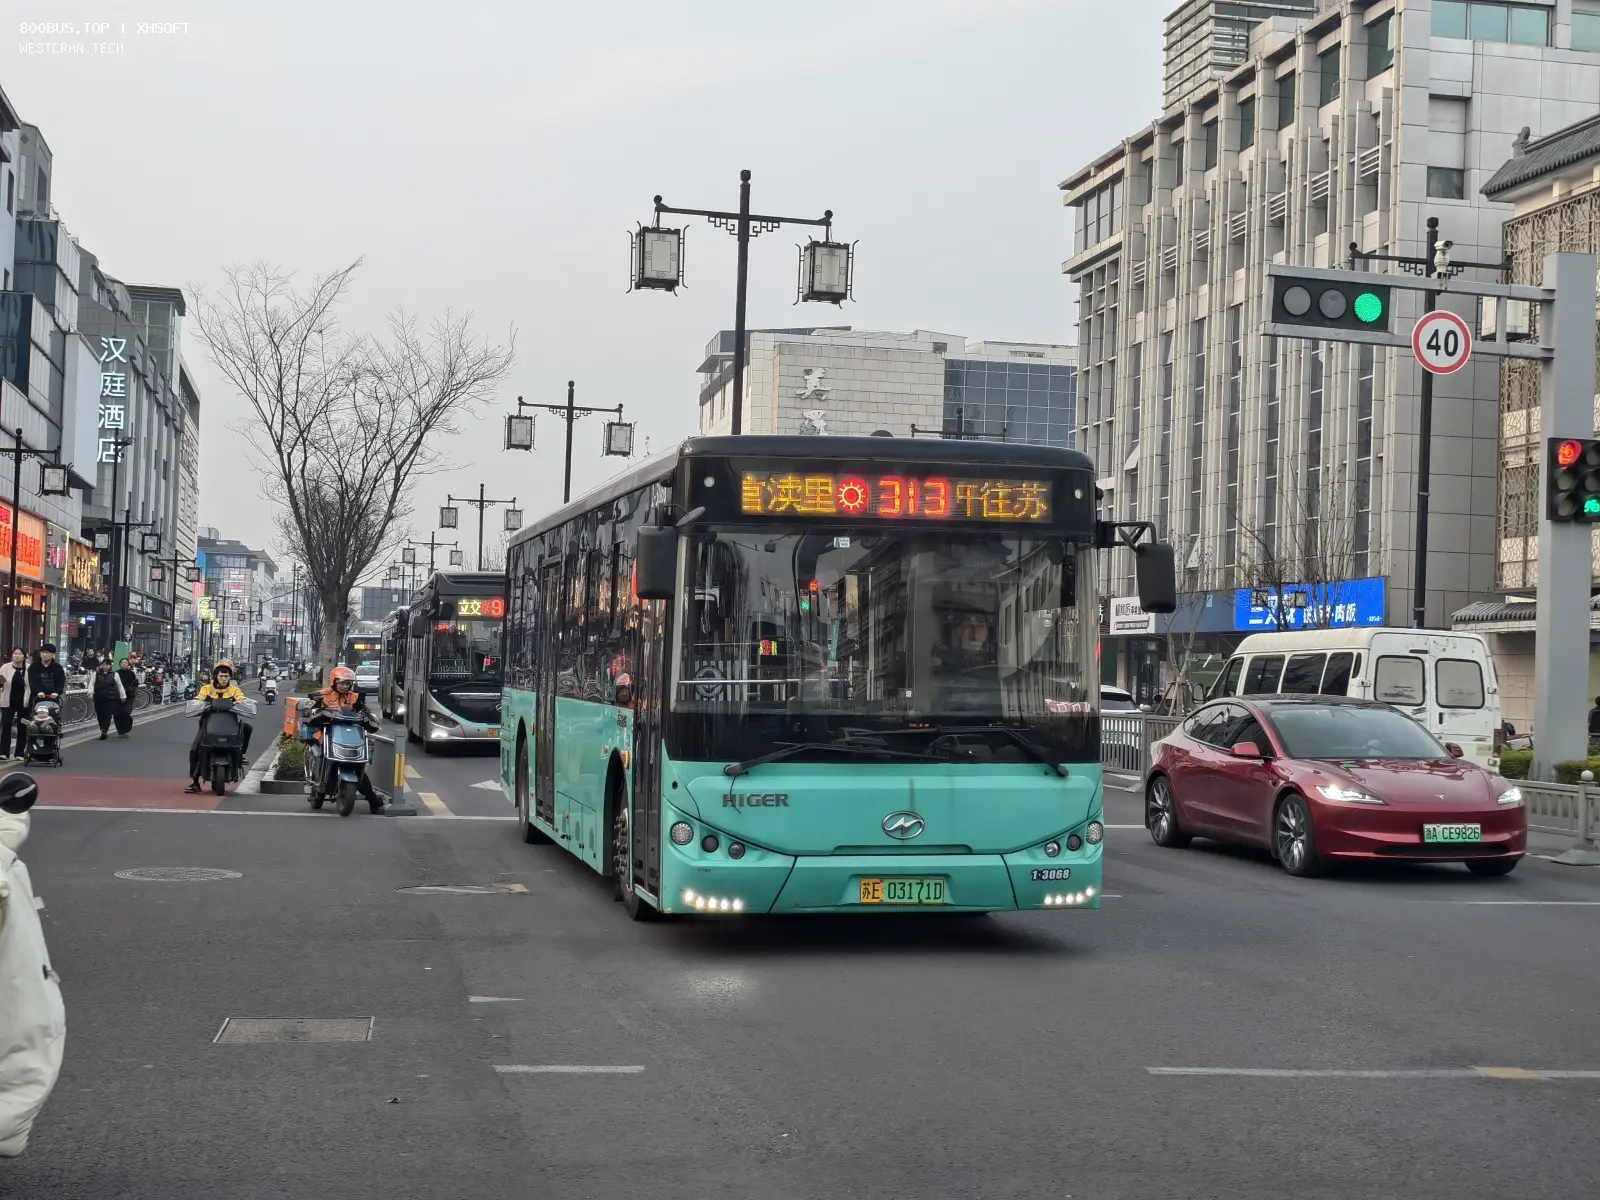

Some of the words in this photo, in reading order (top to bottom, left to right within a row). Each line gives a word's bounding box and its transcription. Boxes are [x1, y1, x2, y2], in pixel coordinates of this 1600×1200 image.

[1426, 329, 1459, 357] 40
[97, 336, 128, 463] 汉庭酒店
[878, 478, 947, 515] 313
[458, 599, 482, 615] 立交
[722, 793, 789, 808] HIGER
[1442, 827, 1480, 840] CE9826
[862, 881, 881, 900] 苏E
[888, 882, 943, 900] 03171D
